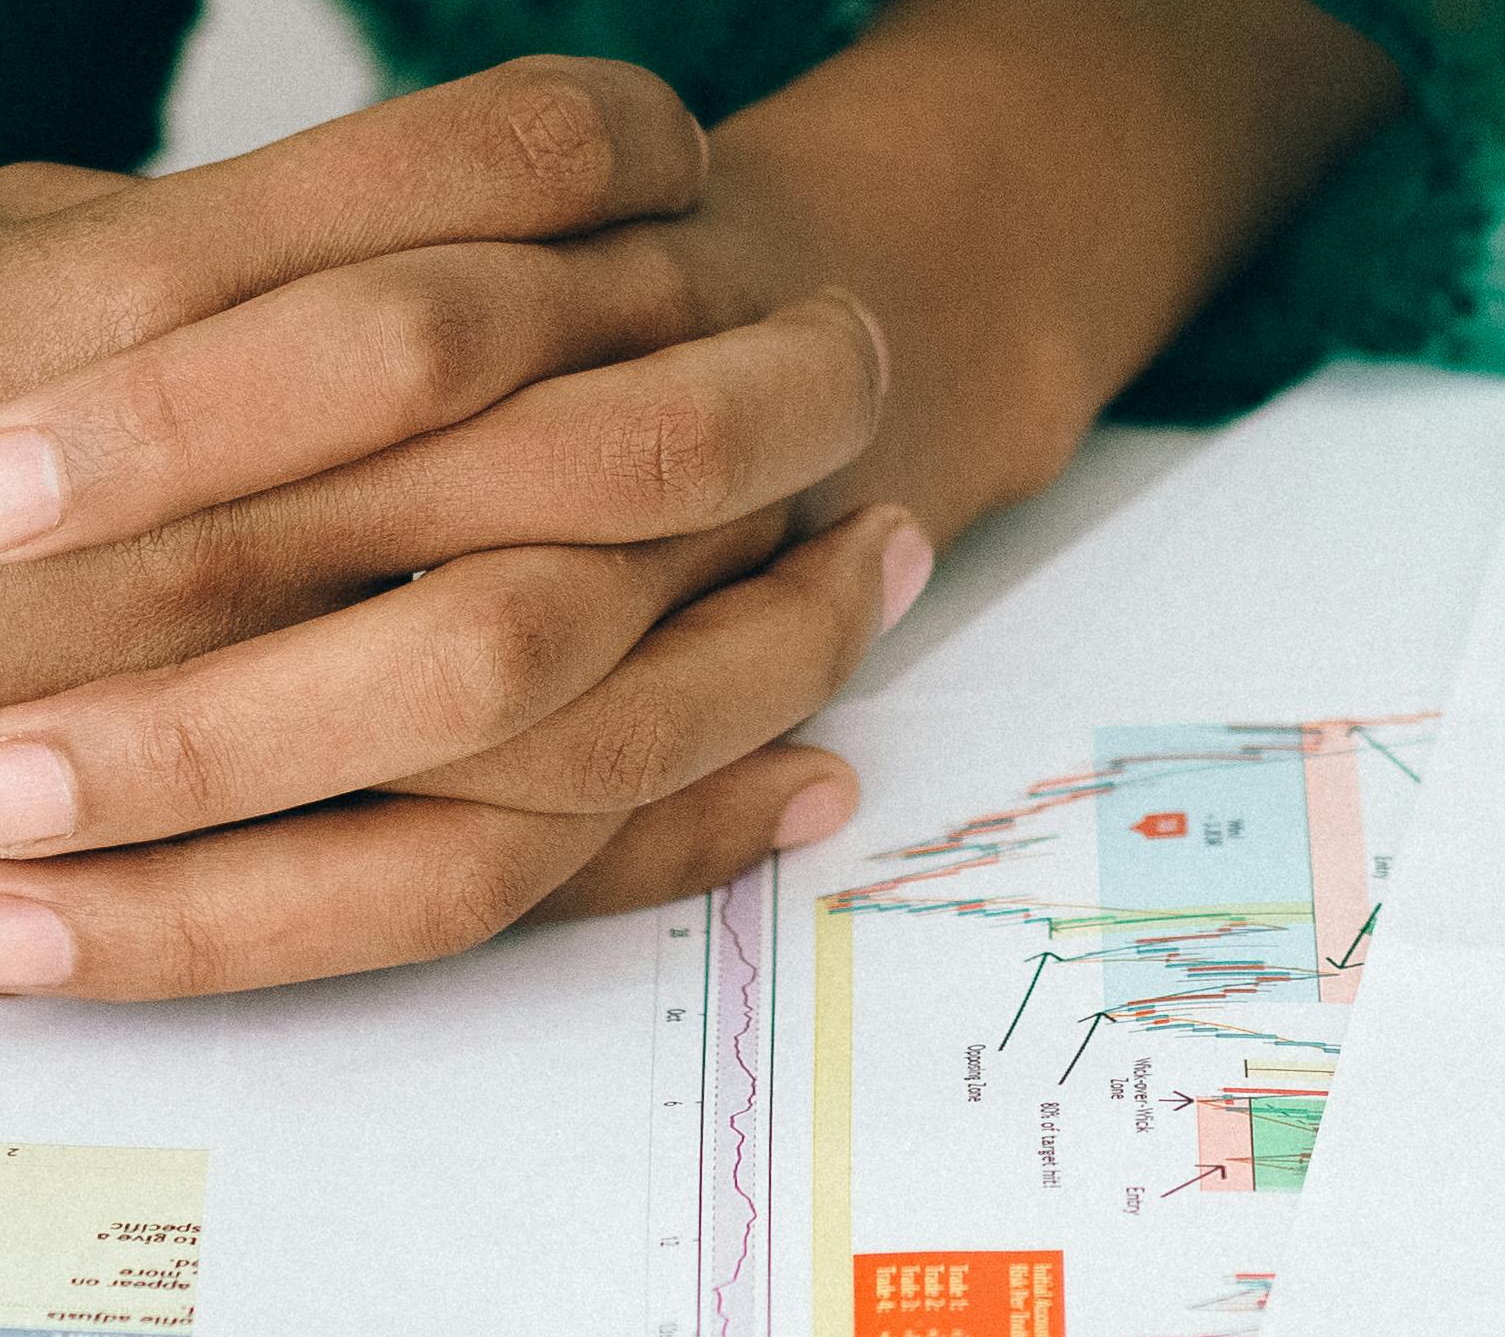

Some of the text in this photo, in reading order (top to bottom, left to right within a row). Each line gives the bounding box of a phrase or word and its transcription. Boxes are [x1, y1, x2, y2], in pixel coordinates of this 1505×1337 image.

[667, 1007, 687, 1022] Oct
[964, 1044, 987, 1103] Opposing Zone
[1110, 1077, 1129, 1101] Zone
[1133, 1056, 1155, 1134] Wick-over-Wick
[7, 1147, 20, 1157] 2
[1038, 1102, 1062, 1189] 80% of target hit!
[1123, 1186, 1146, 1215] Entry
[97, 1232, 198, 1246] to give a
[110, 1222, 202, 1234] specific
[70, 1277, 191, 1291] appear on
[118, 1268, 182, 1278] more
[876, 1266, 897, 1299] Trade
[900, 1265, 921, 1298] Trade
[924, 1265, 945, 1298] Trade
[949, 1265, 970, 1297] Trade
[47, 1310, 131, 1324] adjusts
